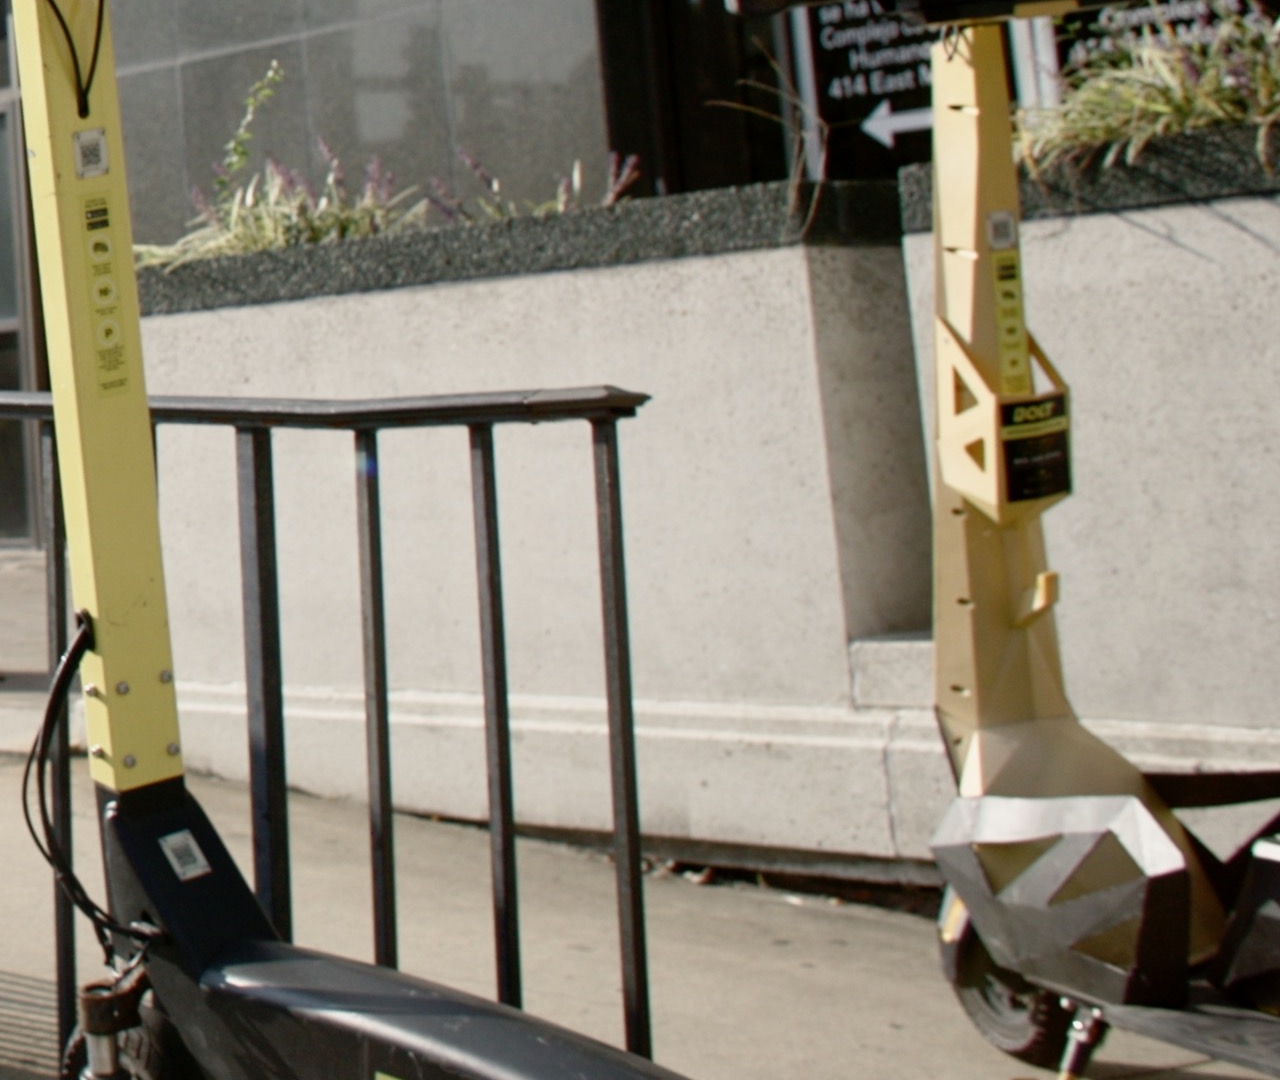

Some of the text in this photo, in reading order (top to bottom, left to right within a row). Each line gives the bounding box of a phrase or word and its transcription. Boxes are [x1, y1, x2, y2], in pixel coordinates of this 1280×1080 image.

[820, 18, 900, 51] Complejo
[848, 40, 932, 71] Humano
[827, 72, 867, 99] 414
[869, 69, 916, 96] East
